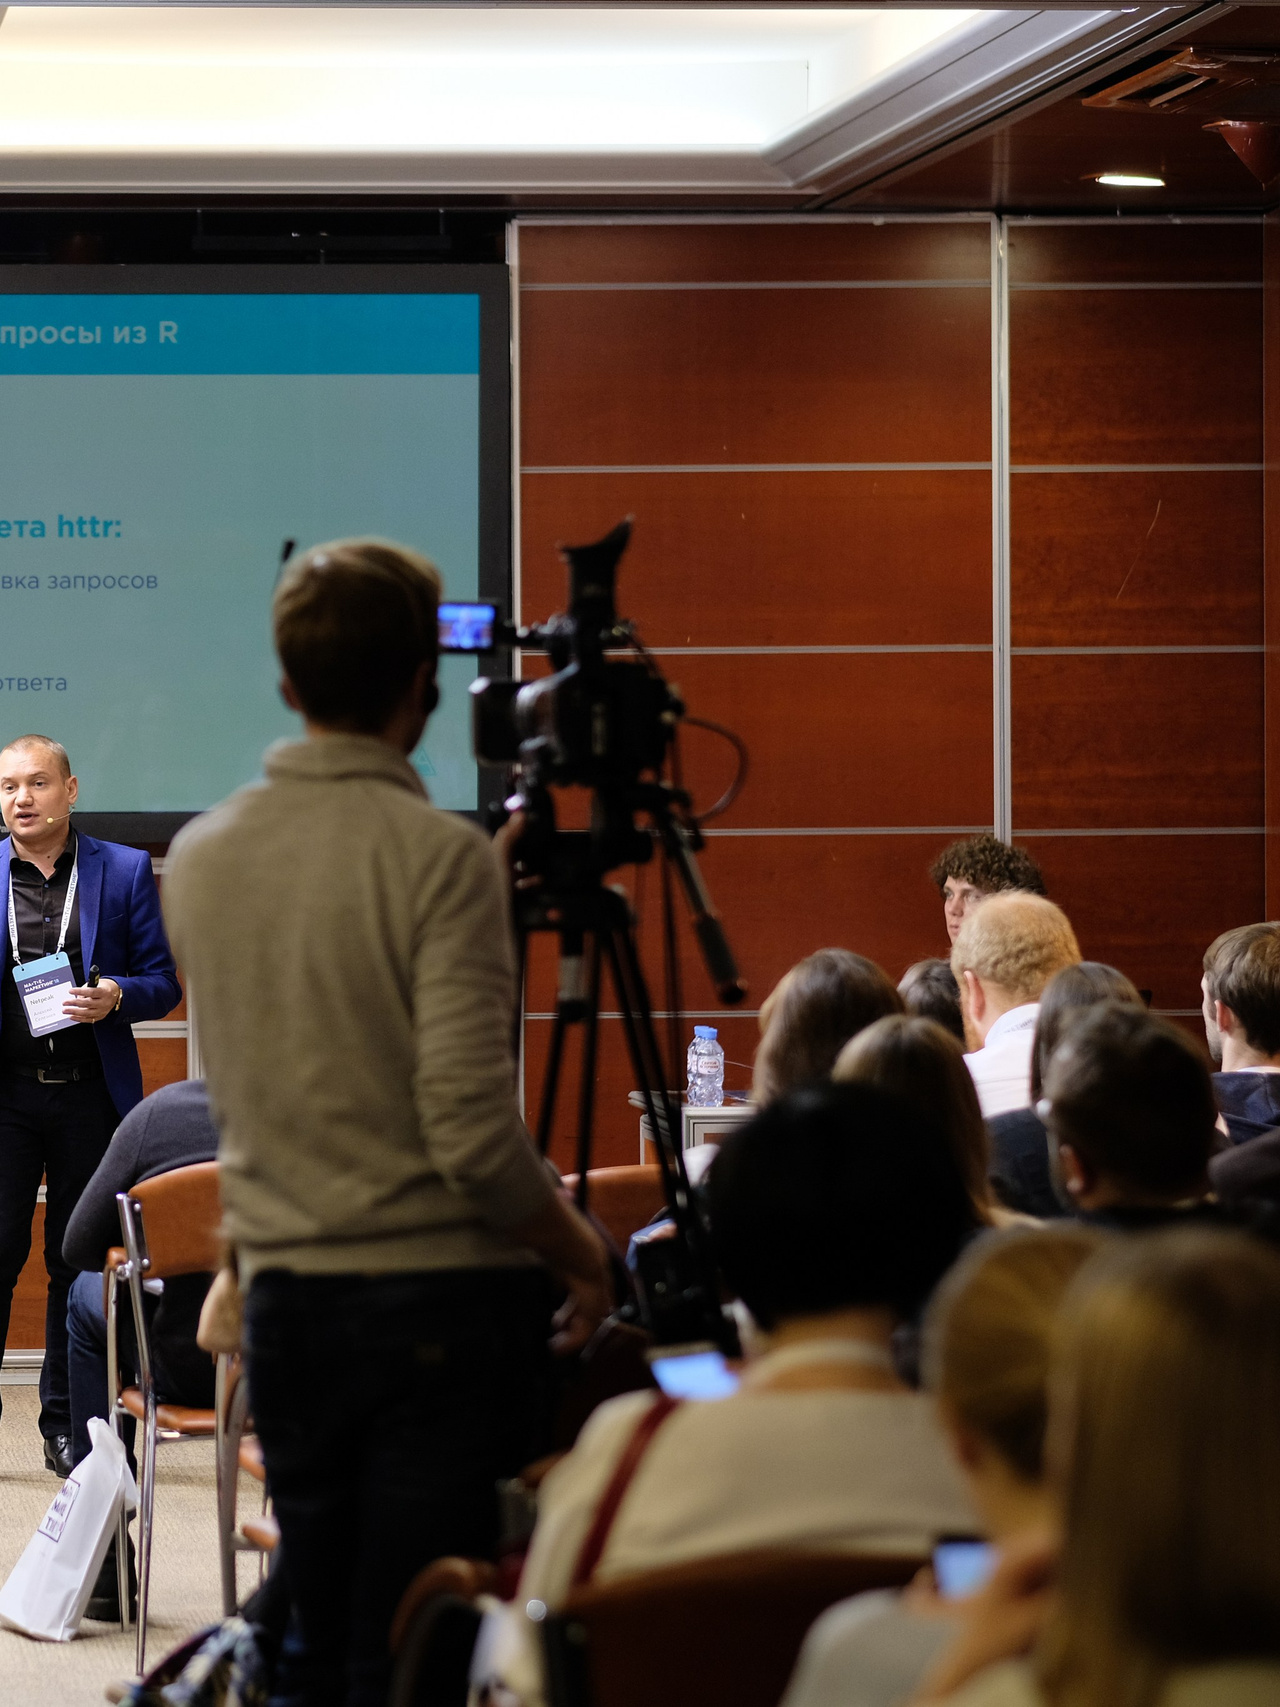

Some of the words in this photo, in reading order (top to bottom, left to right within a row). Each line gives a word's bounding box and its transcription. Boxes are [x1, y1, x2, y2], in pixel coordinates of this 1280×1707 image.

[113, 325, 147, 344] из
[159, 320, 179, 344] R
[57, 514, 122, 539] httr:
[47, 574, 159, 592] запросов
[30, 994, 55, 1006] Netpeak
